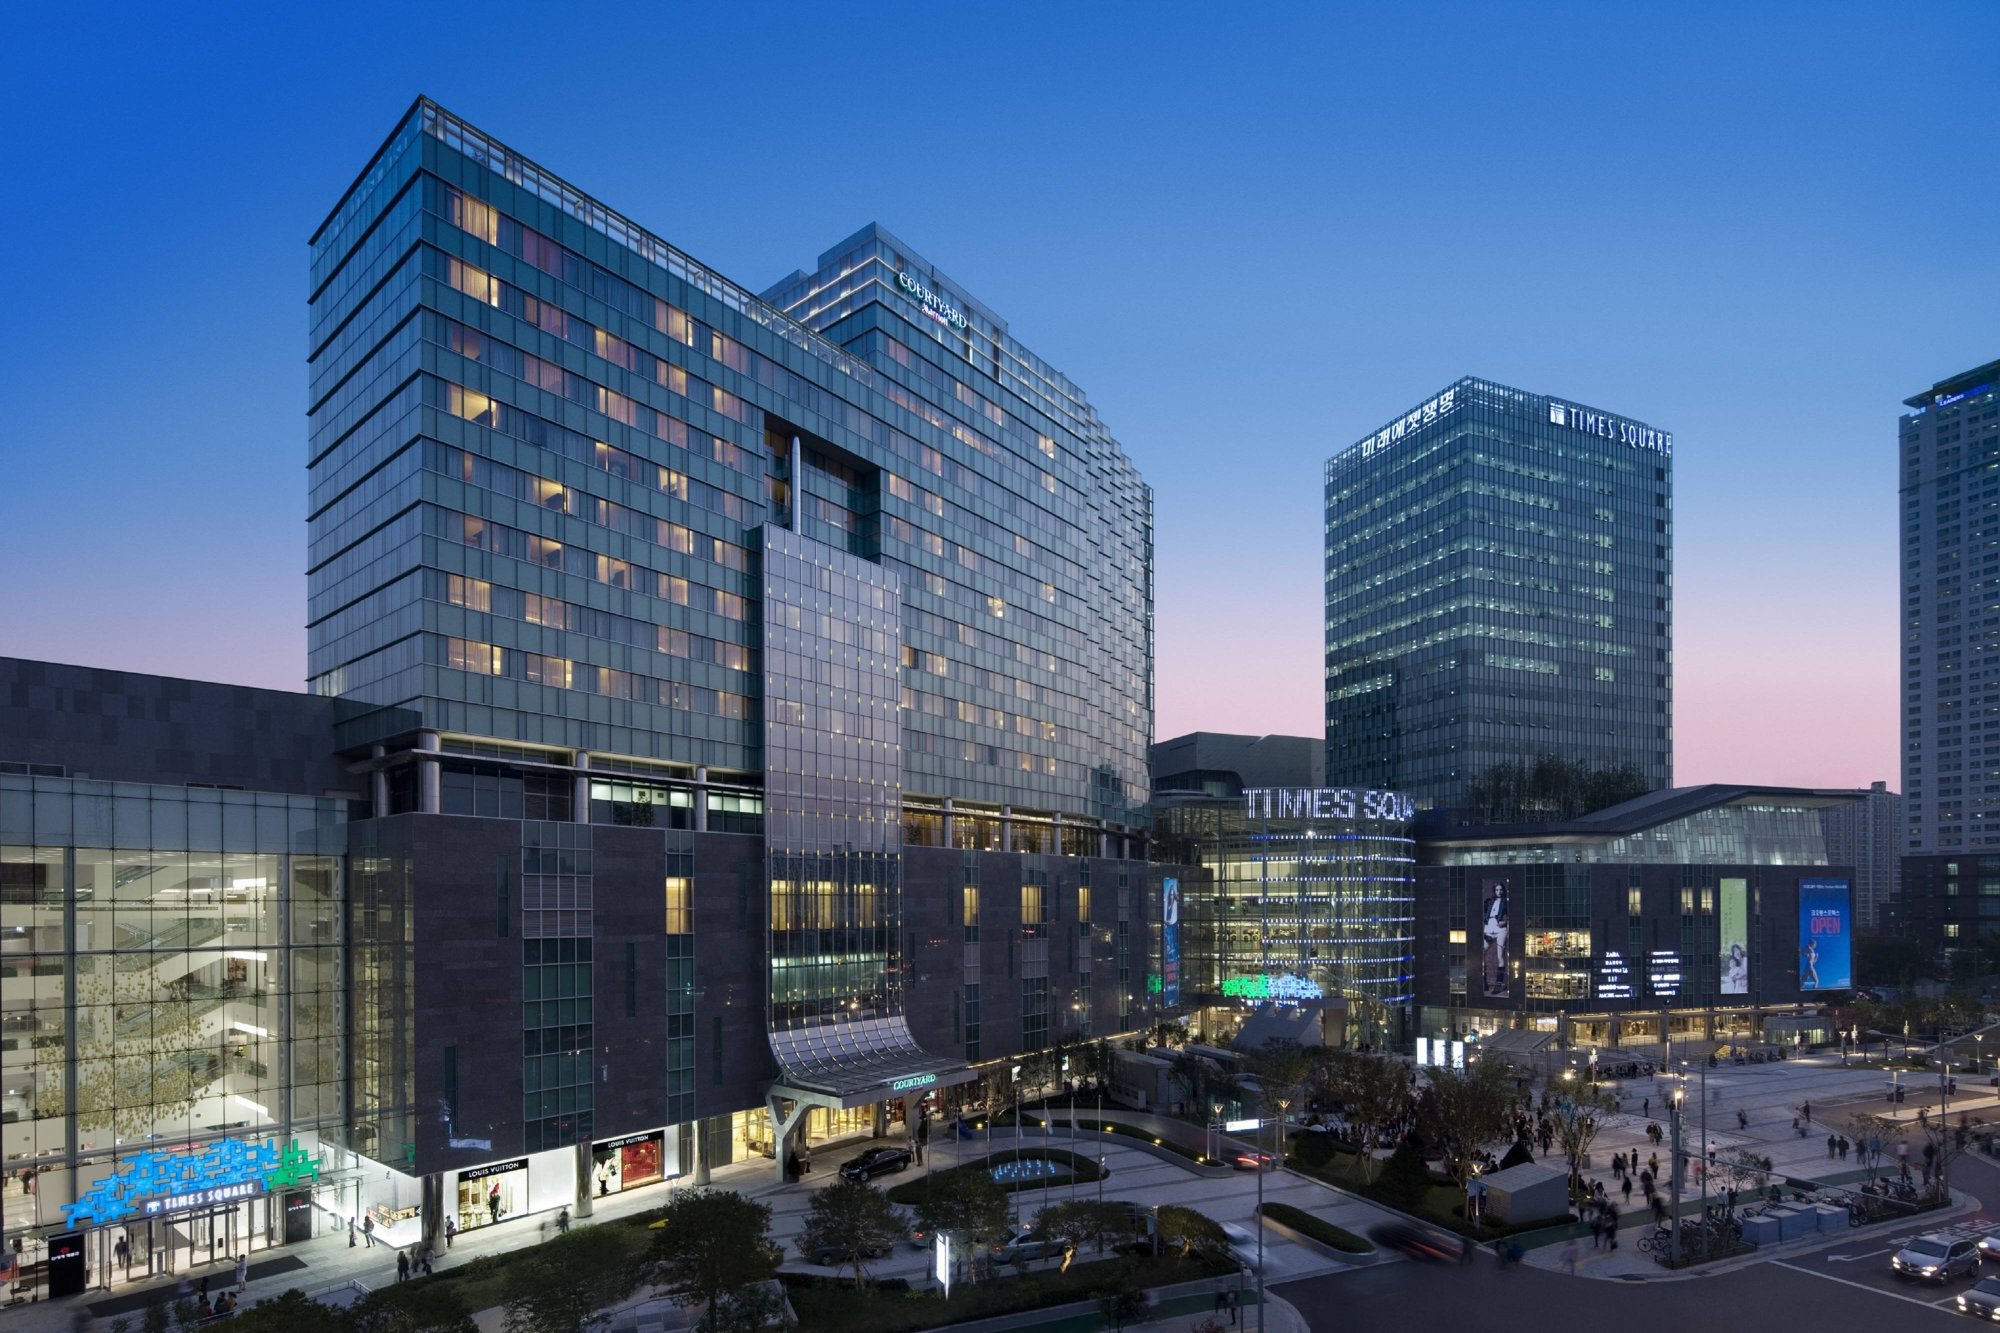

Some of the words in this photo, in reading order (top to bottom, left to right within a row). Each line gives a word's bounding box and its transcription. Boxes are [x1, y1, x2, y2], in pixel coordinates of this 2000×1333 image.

[899, 272, 967, 328] COURTYARD
[1361, 388, 1455, 458] 미래에셋생명
[1570, 408, 1614, 439] TIMES
[1620, 423, 1672, 455] SQUARE
[1242, 788, 1356, 819] TIMES
[1810, 917, 1841, 935] OPEN
[893, 1074, 936, 1090] COURTYARD
[608, 1140, 625, 1149] LOUIS
[626, 1134, 649, 1145] VUITTON
[468, 1167, 489, 1179] LOUIS
[490, 1162, 519, 1174] VUITTON
[164, 1192, 202, 1210] TIMES
[207, 1183, 254, 1202] SQUARE
